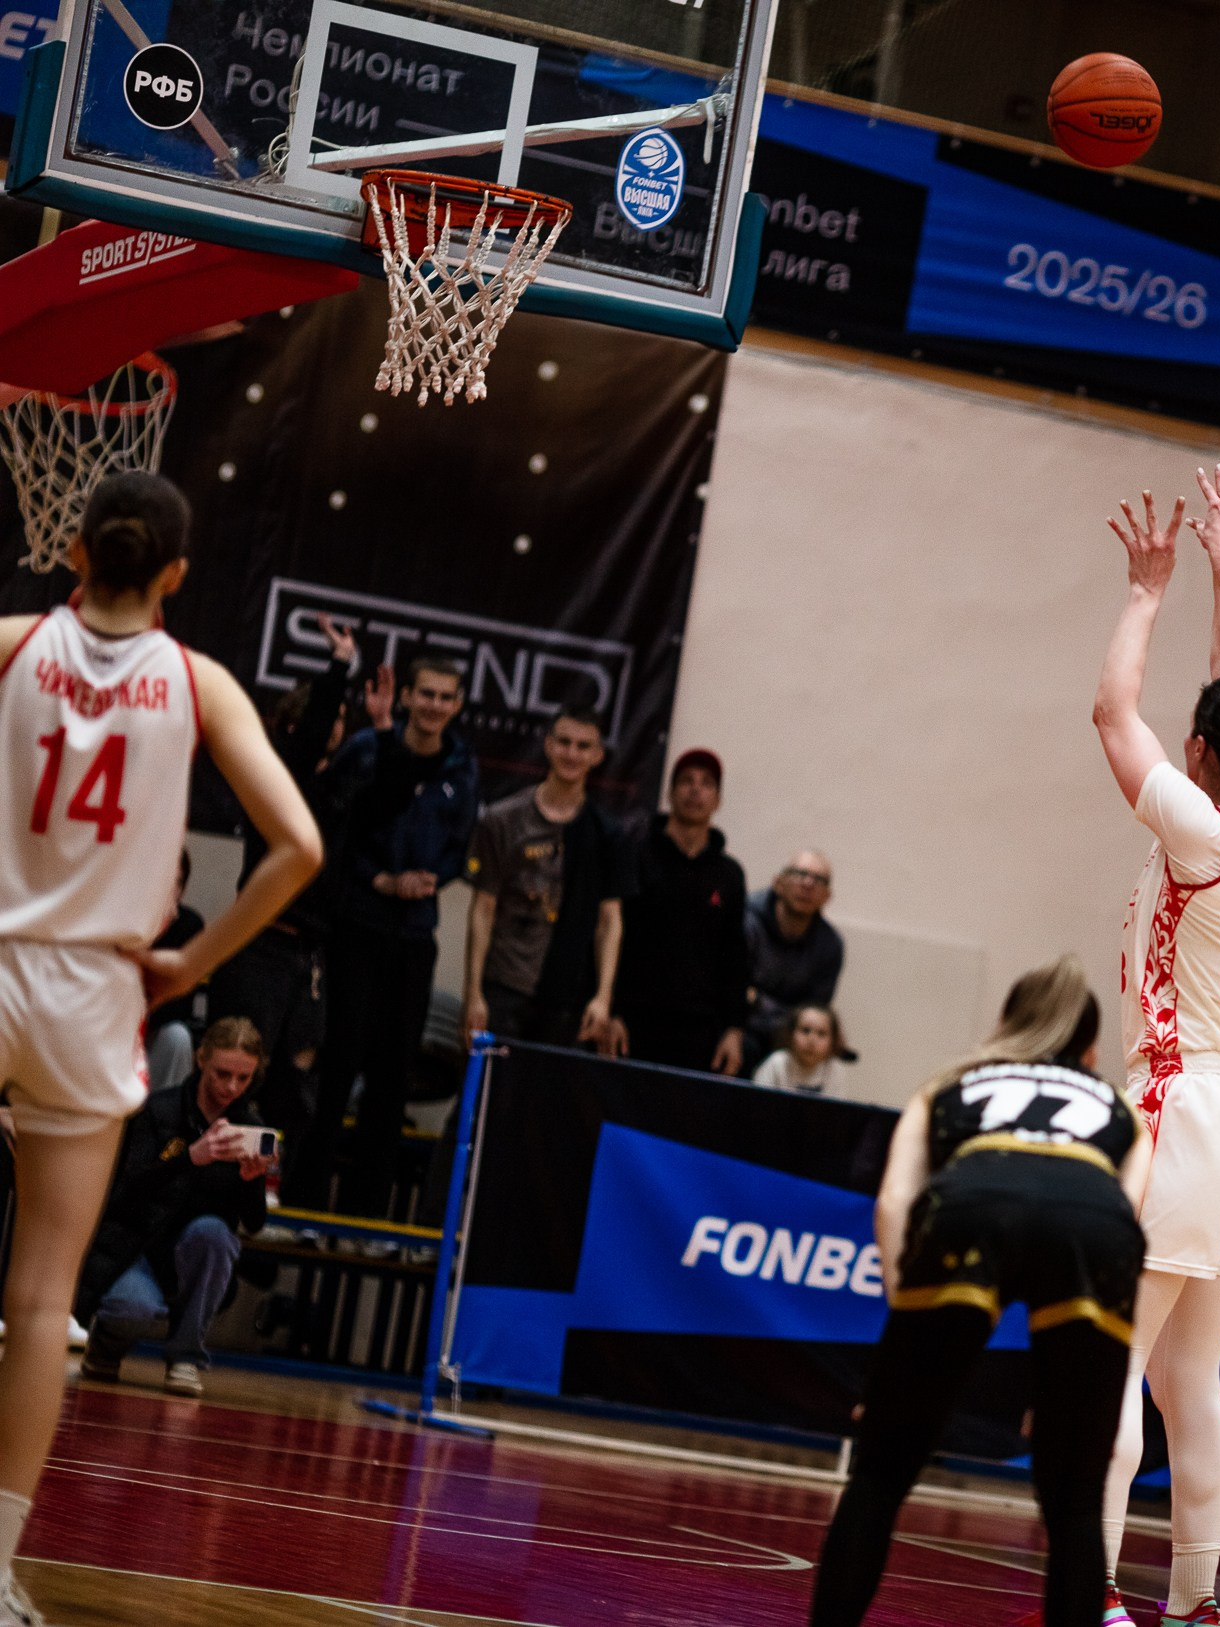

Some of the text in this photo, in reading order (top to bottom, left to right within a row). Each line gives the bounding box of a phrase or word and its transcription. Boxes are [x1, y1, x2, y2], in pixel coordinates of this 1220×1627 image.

[134, 70, 194, 102] РФБ
[624, 186, 671, 211] ВЫСШАЯ
[632, 176, 668, 190] FONBET
[761, 250, 851, 292] лига
[1004, 243, 1208, 329] 2025/26
[31, 725, 127, 843] 14
[681, 1215, 884, 1298] FONBE
